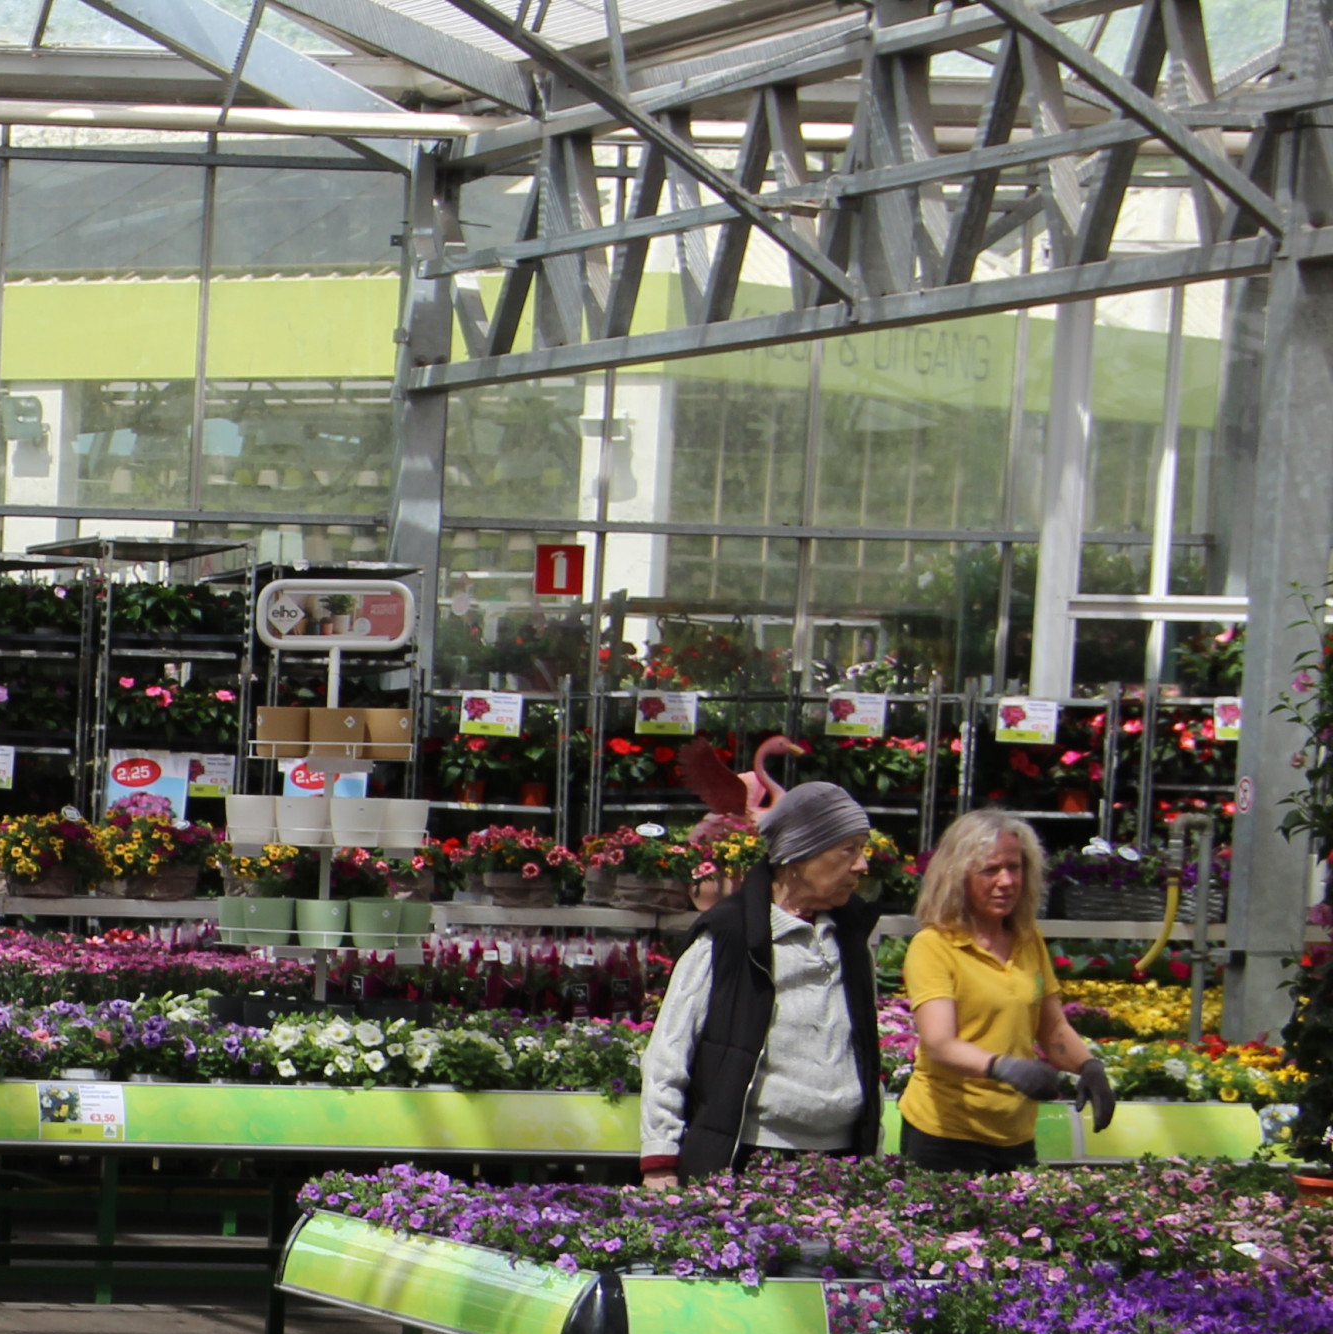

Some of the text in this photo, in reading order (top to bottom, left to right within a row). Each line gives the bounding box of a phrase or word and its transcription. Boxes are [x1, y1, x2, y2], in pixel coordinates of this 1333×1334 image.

[271, 605, 298, 618] elho
[116, 765, 151, 782] 2,25
[90, 1113, 116, 1122] €3,50
